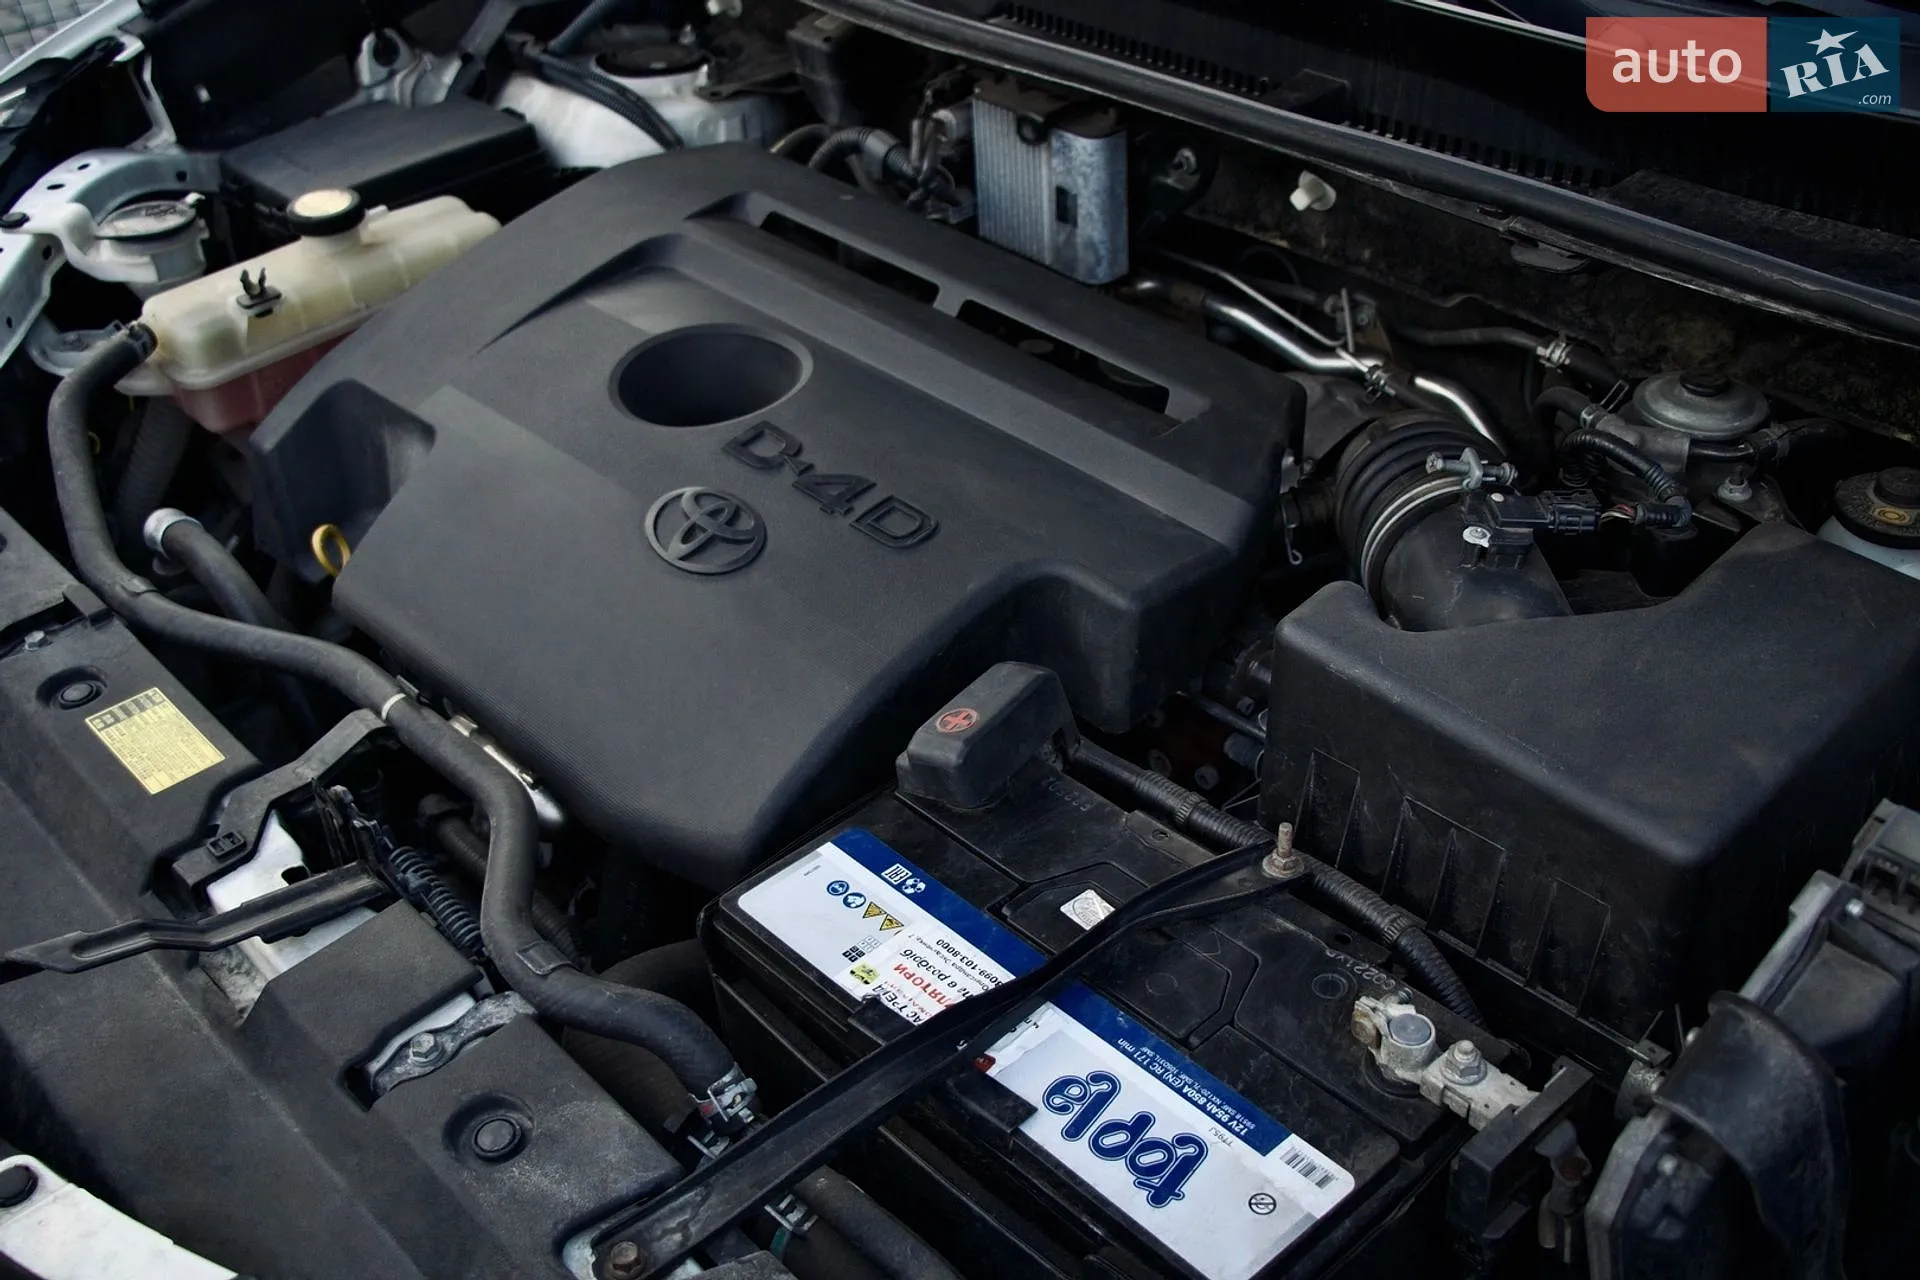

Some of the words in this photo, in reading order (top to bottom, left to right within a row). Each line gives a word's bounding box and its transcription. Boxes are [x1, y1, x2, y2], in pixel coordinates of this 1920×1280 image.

[900, 949, 951, 981] роздріб
[894, 963, 955, 1008] ЛЯТОРИ
[1117, 1038, 1136, 1053] min
[1133, 1051, 1153, 1066] 171
[1149, 1062, 1164, 1074] RC
[1162, 1072, 1184, 1088] (EN)
[1182, 1085, 1207, 1105] 850A
[1206, 1103, 1229, 1122] 95Ah
[1227, 1121, 1248, 1136] 12V
[1042, 1070, 1208, 1208] topla
